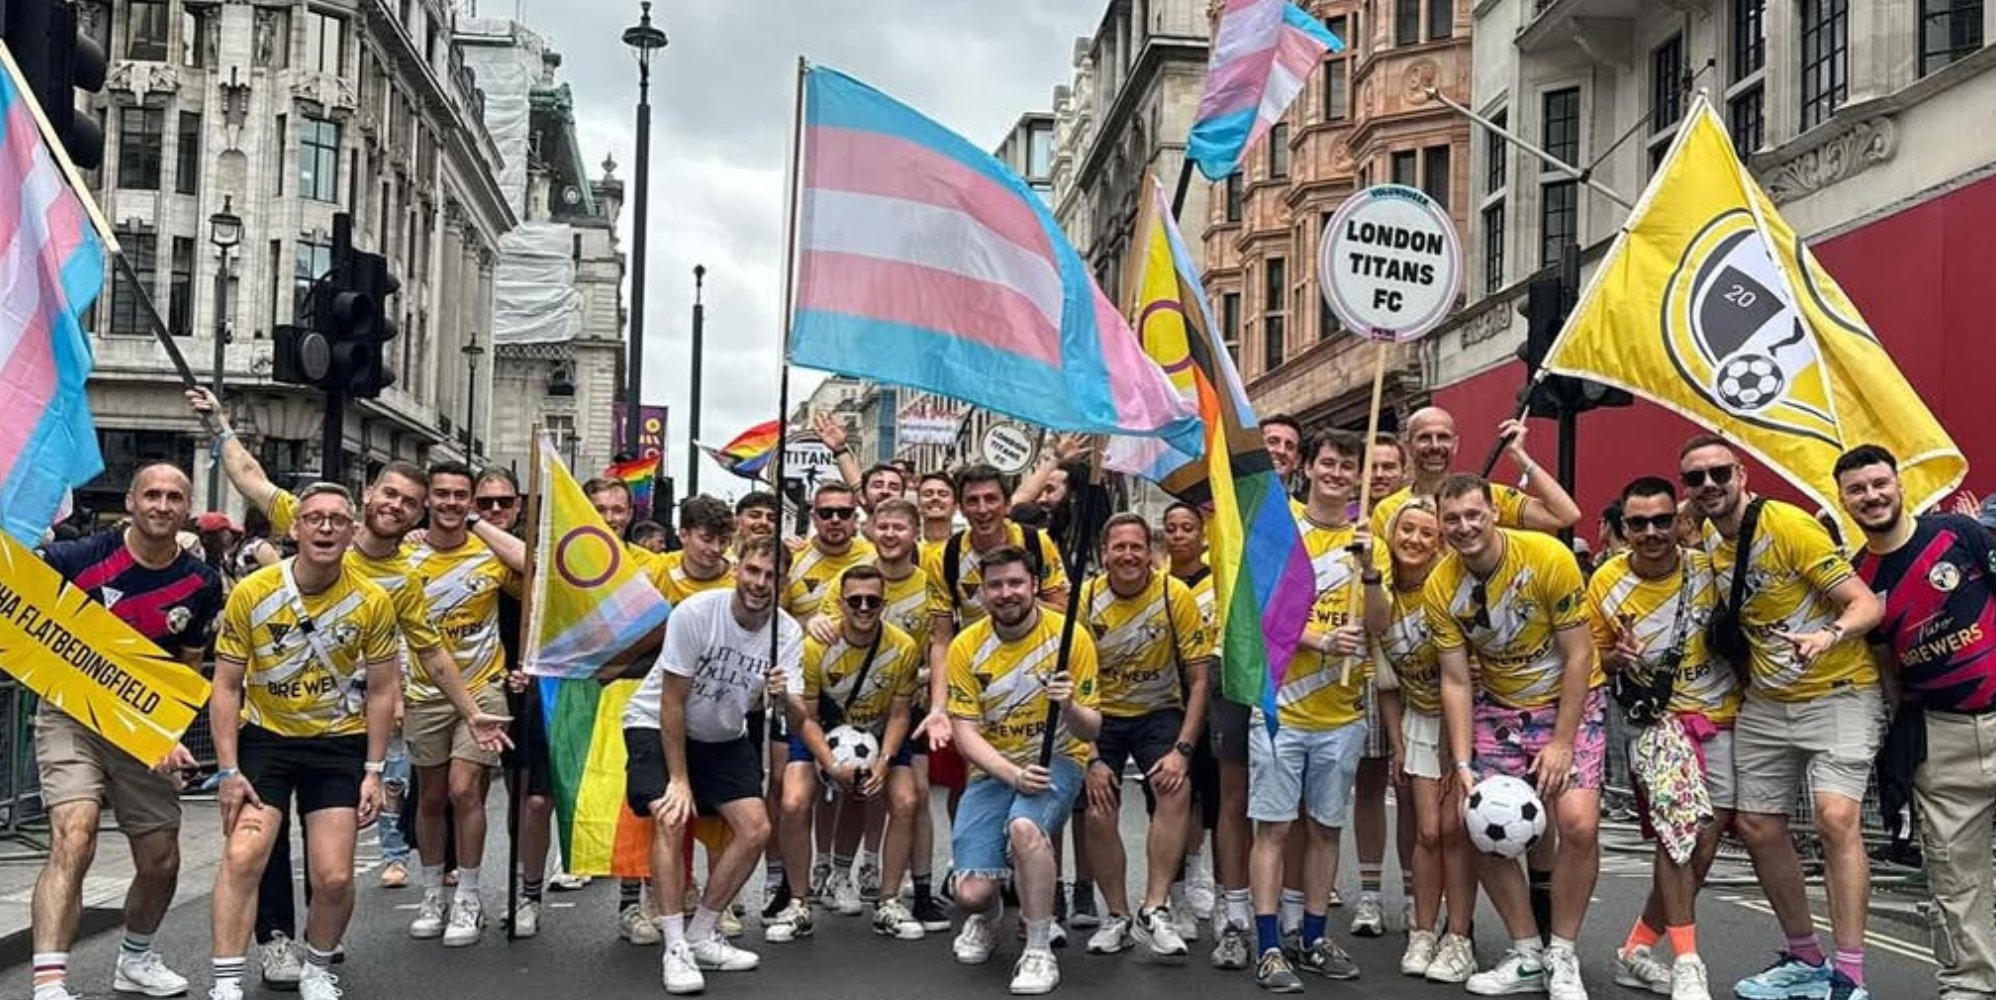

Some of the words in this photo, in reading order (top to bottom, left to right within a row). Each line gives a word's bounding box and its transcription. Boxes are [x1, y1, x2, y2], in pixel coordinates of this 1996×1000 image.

[1346, 220, 1444, 256] LONDON
[1349, 252, 1435, 286] TITANS
[1373, 288, 1404, 313] FC
[1722, 284, 1757, 308] 20
[991, 430, 1028, 454] LONDON
[0, 582, 21, 620] HA
[14, 603, 162, 716] FLATBEDINGFIELD
[1901, 622, 1984, 667] BREWERS
[267, 676, 338, 698] BREWE
